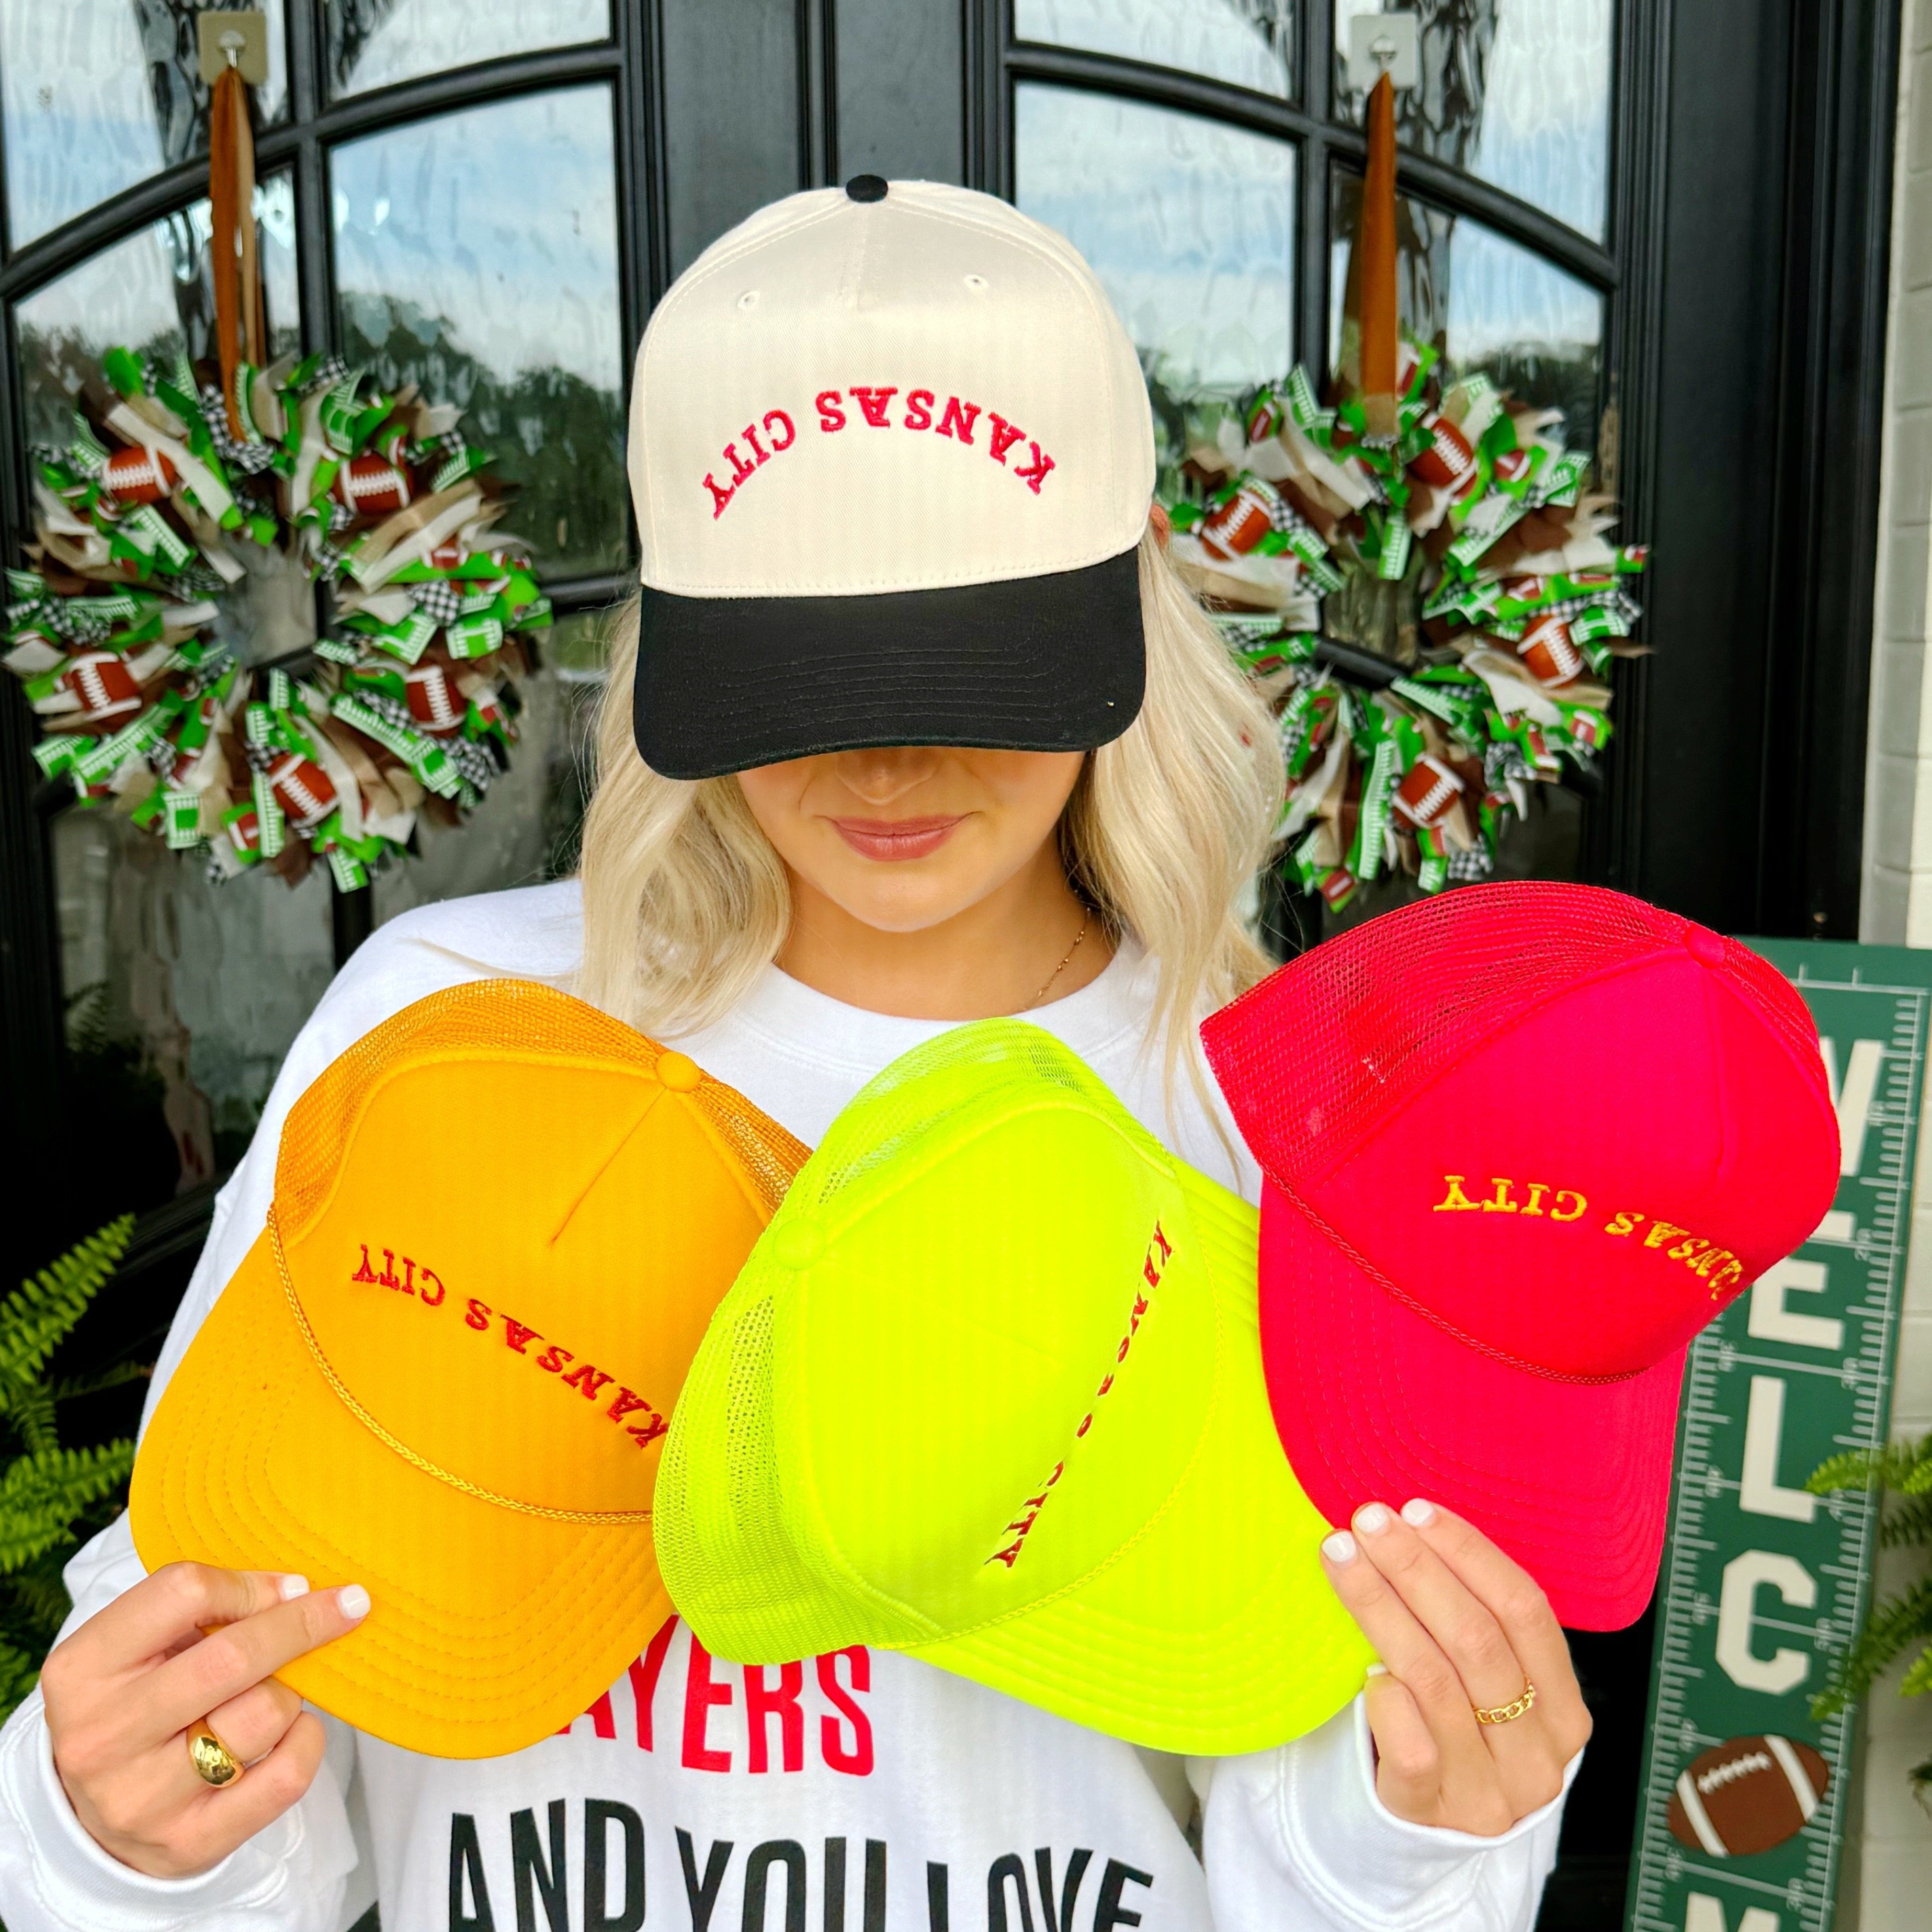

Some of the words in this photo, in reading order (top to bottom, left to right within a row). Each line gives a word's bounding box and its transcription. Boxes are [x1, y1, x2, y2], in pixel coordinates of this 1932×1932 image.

[702, 409, 796, 520] CITY
[814, 386, 1056, 495] KANSAS
[1433, 1175, 1588, 1221] CITY
[351, 1243, 446, 1306] CITY
[1604, 1211, 1744, 1301] ANSAS
[464, 1298, 669, 1449] KANSAS
[448, 1797, 645, 1932] AND
[674, 1825, 887, 1932] YOU
